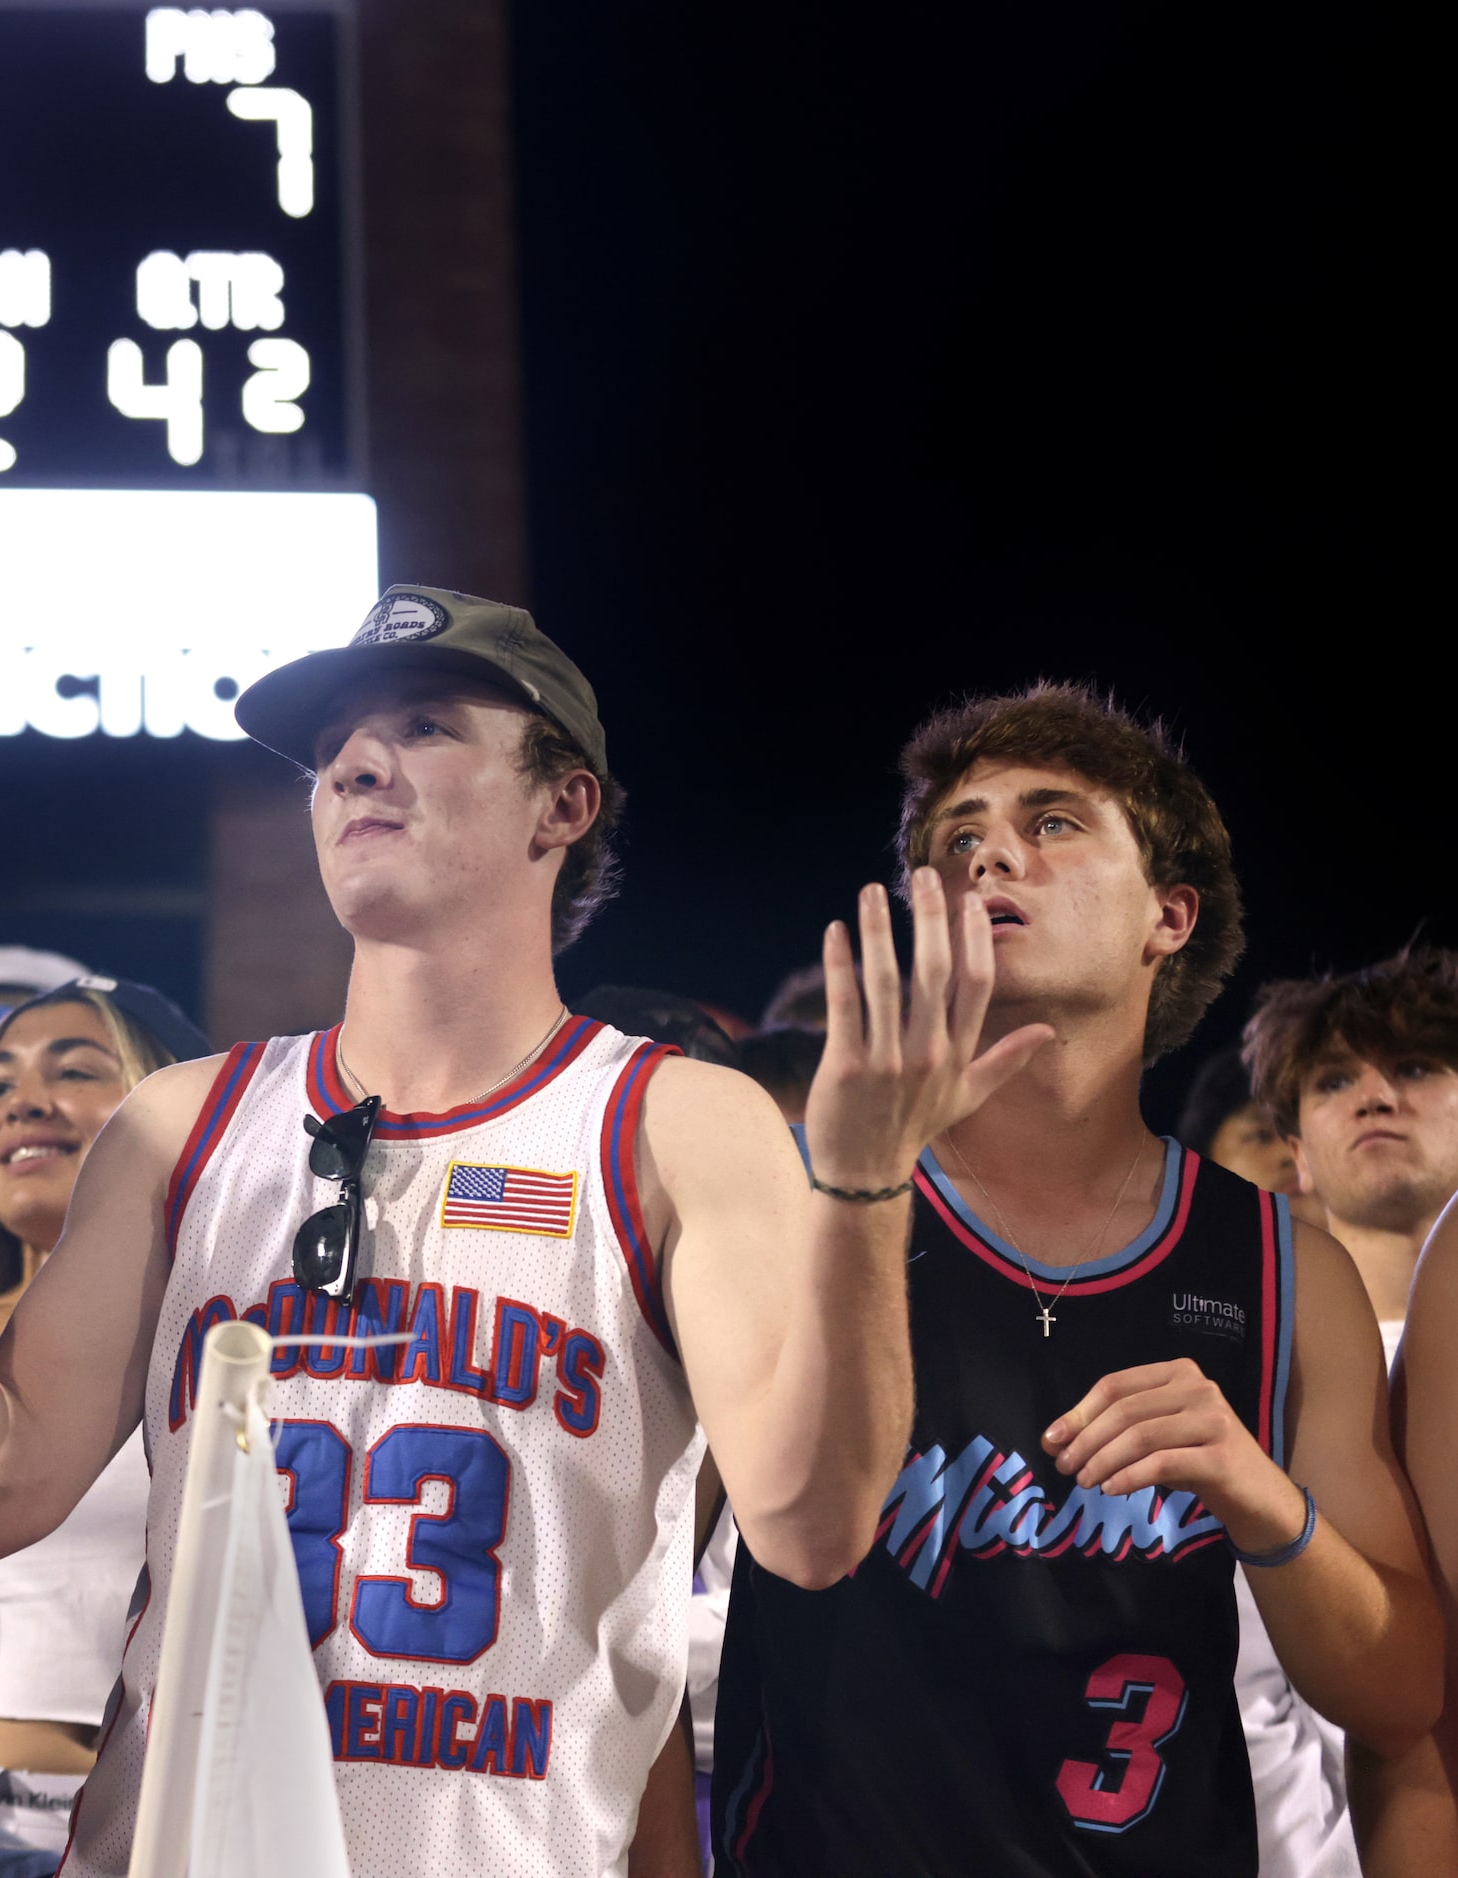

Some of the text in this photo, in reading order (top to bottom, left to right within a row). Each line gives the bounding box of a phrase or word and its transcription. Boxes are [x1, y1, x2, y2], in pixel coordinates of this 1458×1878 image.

[226, 86, 314, 218] 7
[136, 251, 285, 331] QTR
[107, 338, 203, 466] 4
[242, 338, 310, 433] 2
[1173, 1293, 1246, 1325] Ultimate
[1173, 1313, 1246, 1337] SOFTWARE
[1054, 1653, 1190, 1834] 3
